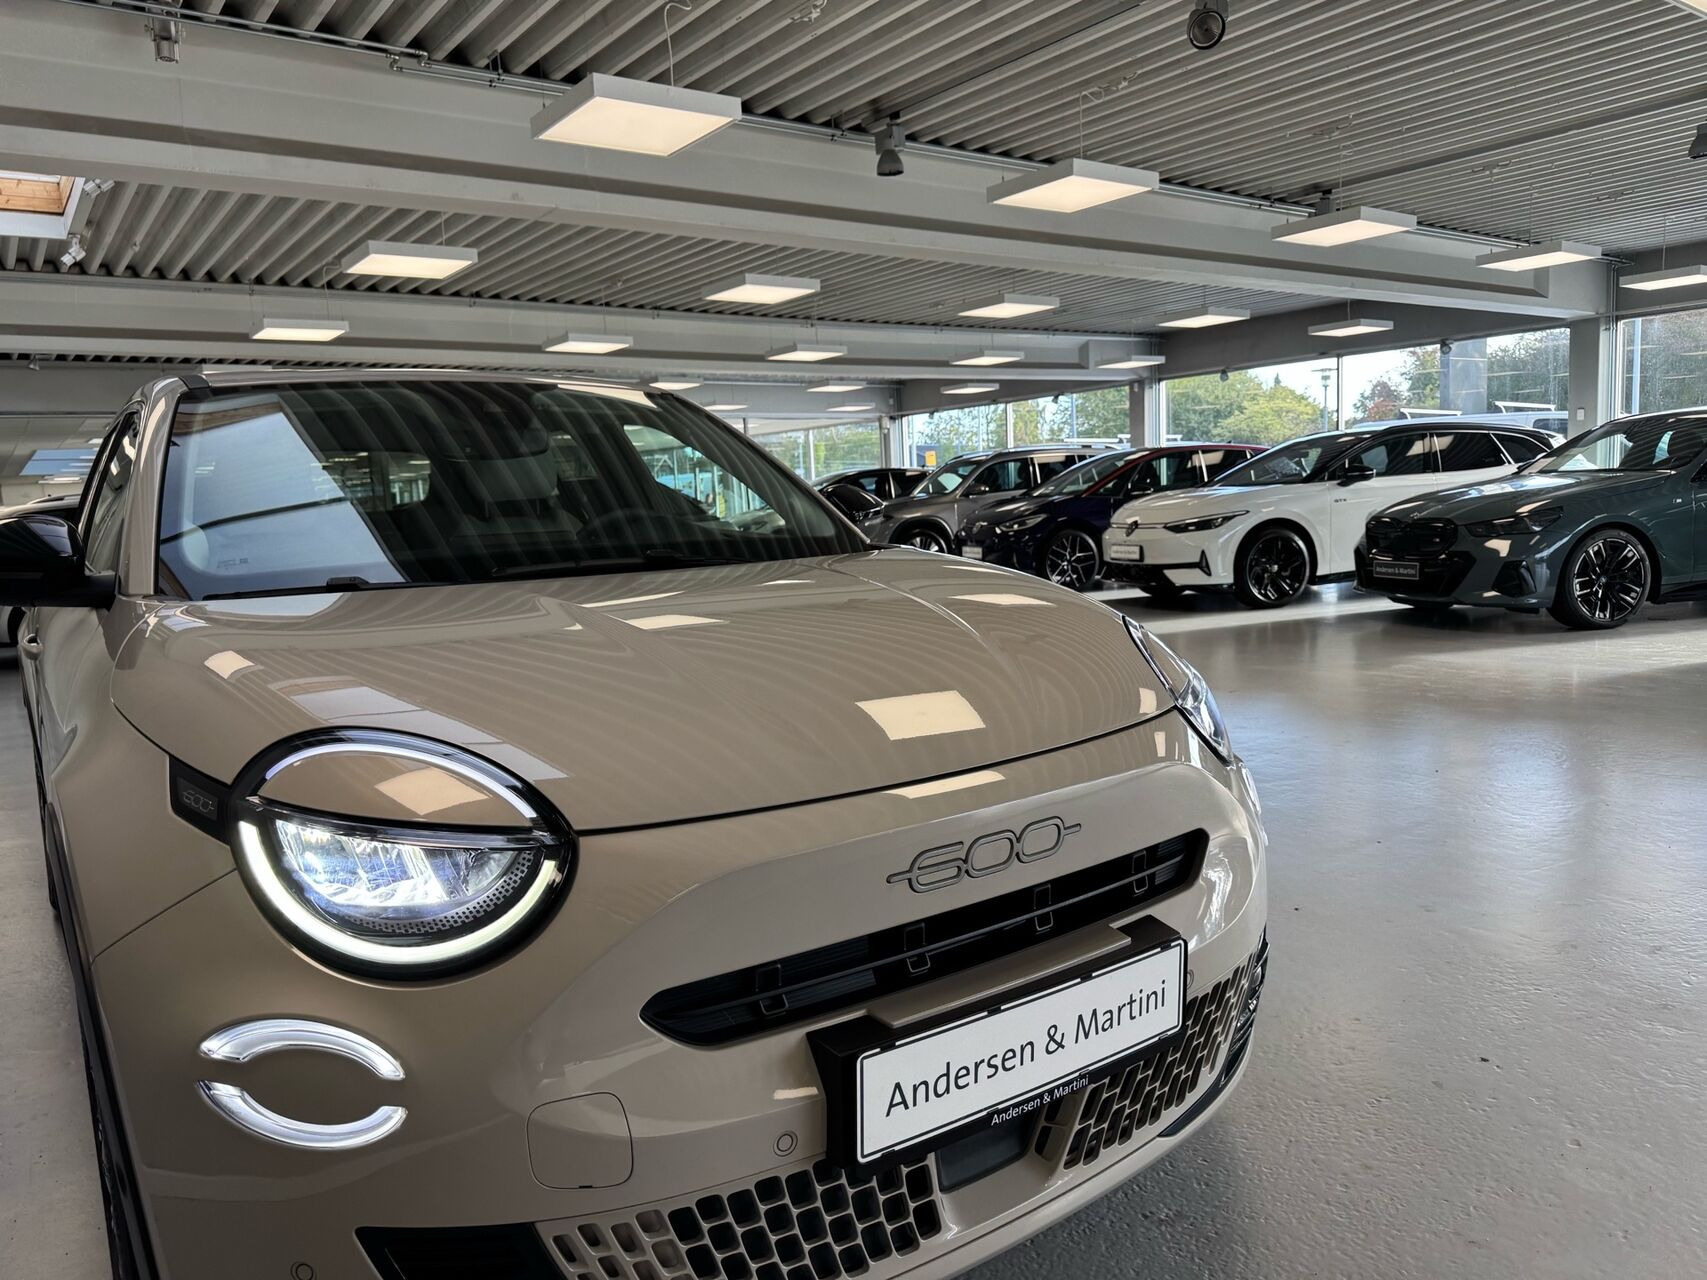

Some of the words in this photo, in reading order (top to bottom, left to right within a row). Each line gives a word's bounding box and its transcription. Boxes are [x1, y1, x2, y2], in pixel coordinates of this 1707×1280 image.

[886, 816, 1081, 893] 600
[885, 1040, 1035, 1118] Andersen
[1044, 1023, 1066, 1055] &
[1074, 979, 1167, 1045] Martini
[990, 1098, 1041, 1127] Andersen
[1042, 1092, 1051, 1104] &
[1053, 1074, 1089, 1100] Martini
